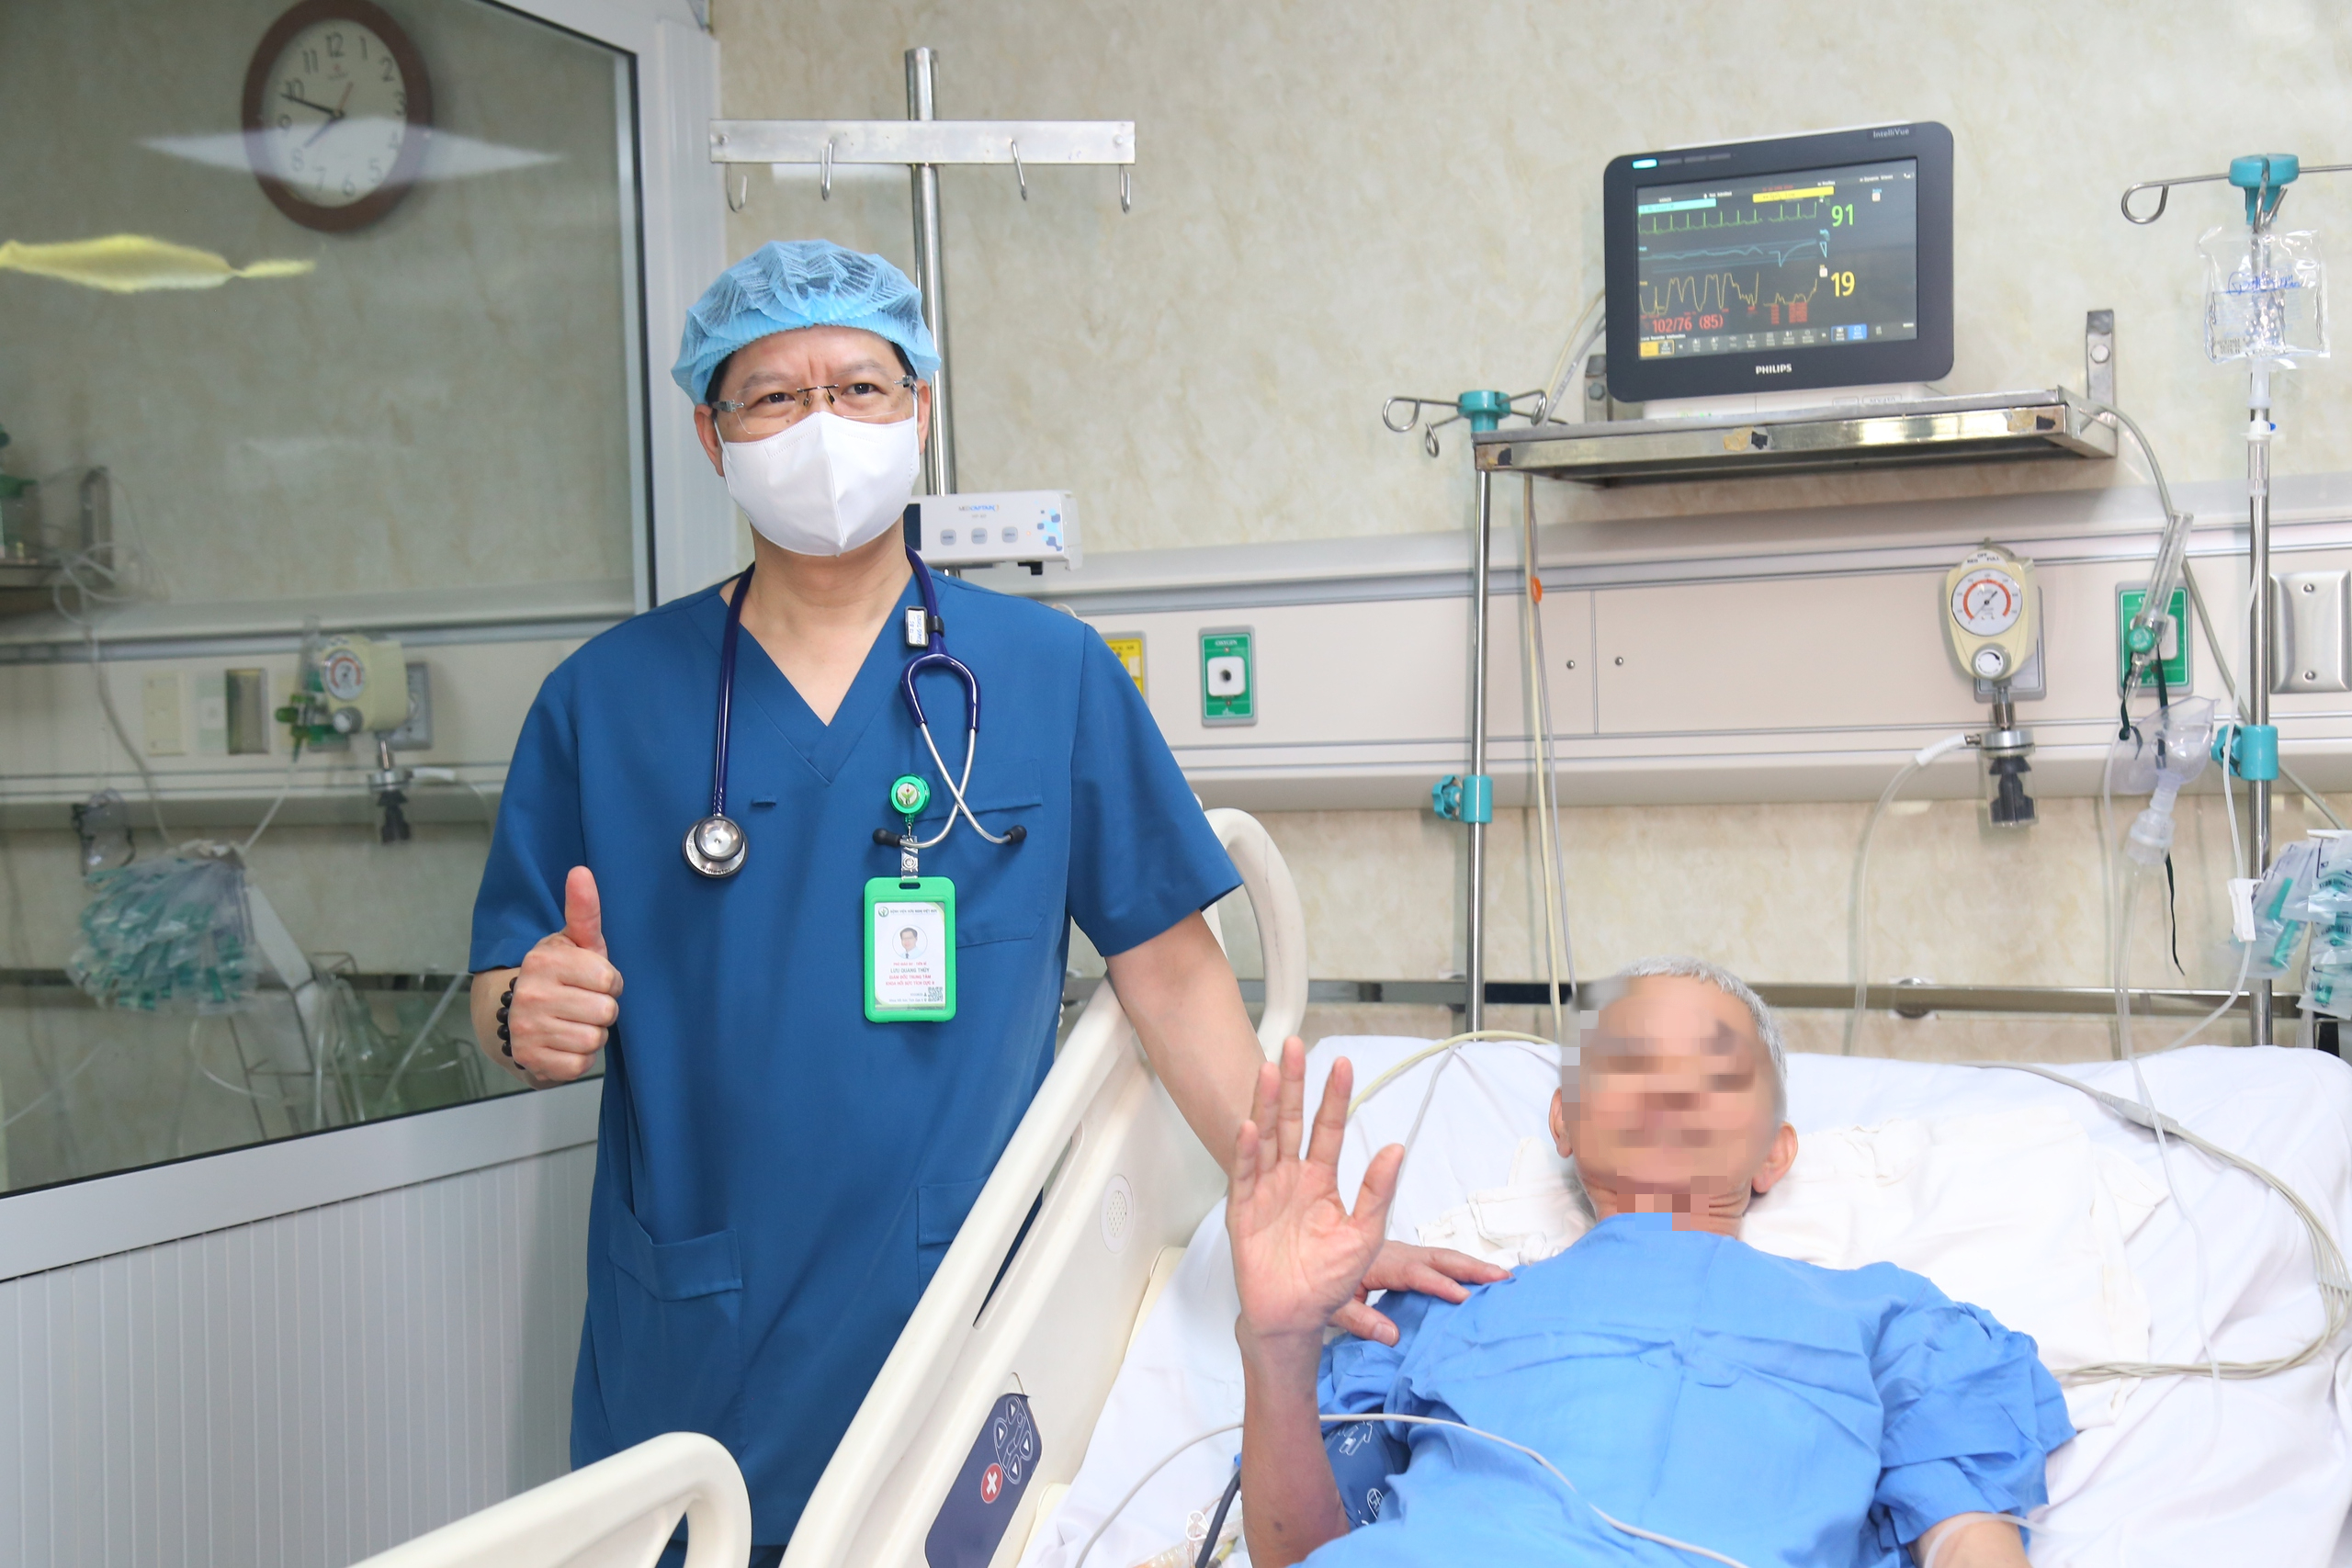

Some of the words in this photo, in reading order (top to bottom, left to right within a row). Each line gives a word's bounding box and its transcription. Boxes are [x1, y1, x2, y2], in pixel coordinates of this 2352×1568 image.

[325, 31, 345, 58] 12
[359, 35, 368, 61] 1
[302, 50, 319, 74] 11
[380, 56, 394, 83] 2
[284, 78, 305, 103] 10
[394, 90, 407, 117] 3
[277, 114, 292, 134] 9
[1872, 127, 1910, 139] IntelliVue
[342, 173, 356, 197] 6
[1831, 204, 1854, 227] 91
[1830, 271, 1855, 297] 19
[1652, 317, 1693, 333] 102/76
[1699, 314, 1724, 331] (85)
[1755, 363, 1792, 375] PHILIPS
